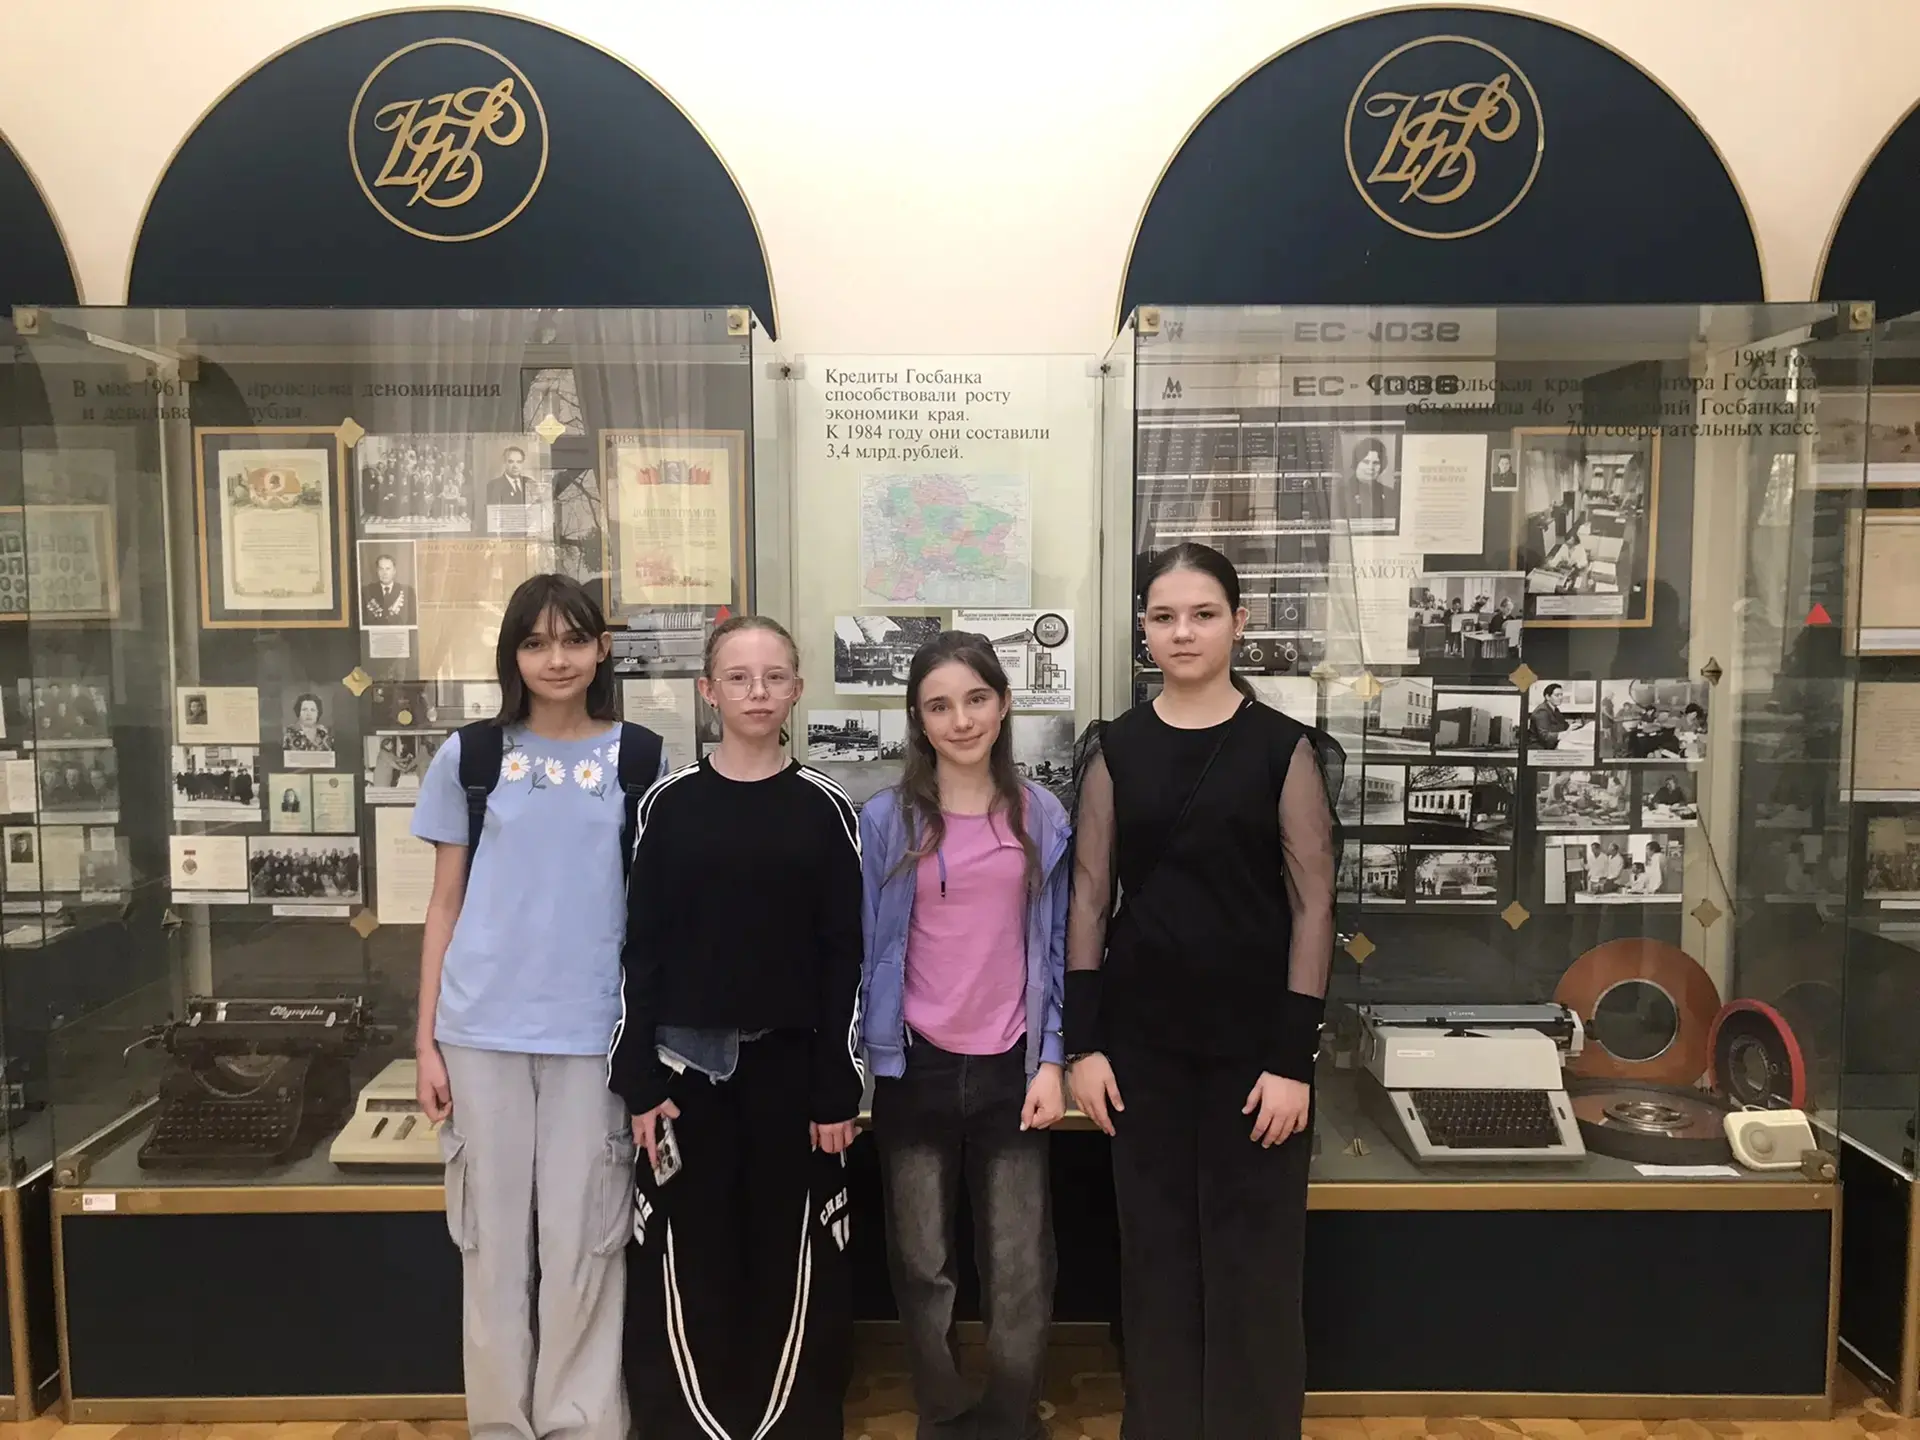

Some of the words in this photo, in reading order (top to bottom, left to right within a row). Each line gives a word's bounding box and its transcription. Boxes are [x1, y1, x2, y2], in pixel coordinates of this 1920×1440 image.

[825, 368, 898, 386] Кредиты
[905, 368, 982, 384] Госбанка
[1723, 373, 1817, 391] Госбанка
[143, 379, 184, 397] 1961
[361, 382, 502, 398] деноминация
[825, 387, 957, 402] способствовали
[965, 390, 1011, 405] росту
[1531, 398, 1555, 416] 46
[1701, 397, 1795, 415] Госбанка
[825, 408, 919, 421] экономики
[927, 409, 970, 424] края.
[826, 424, 839, 439] К
[847, 424, 882, 440] 1984
[887, 427, 923, 442] году
[929, 428, 960, 440] они
[965, 428, 1050, 440] составили
[1770, 421, 1820, 437] касс.
[826, 443, 850, 460] 3,4
